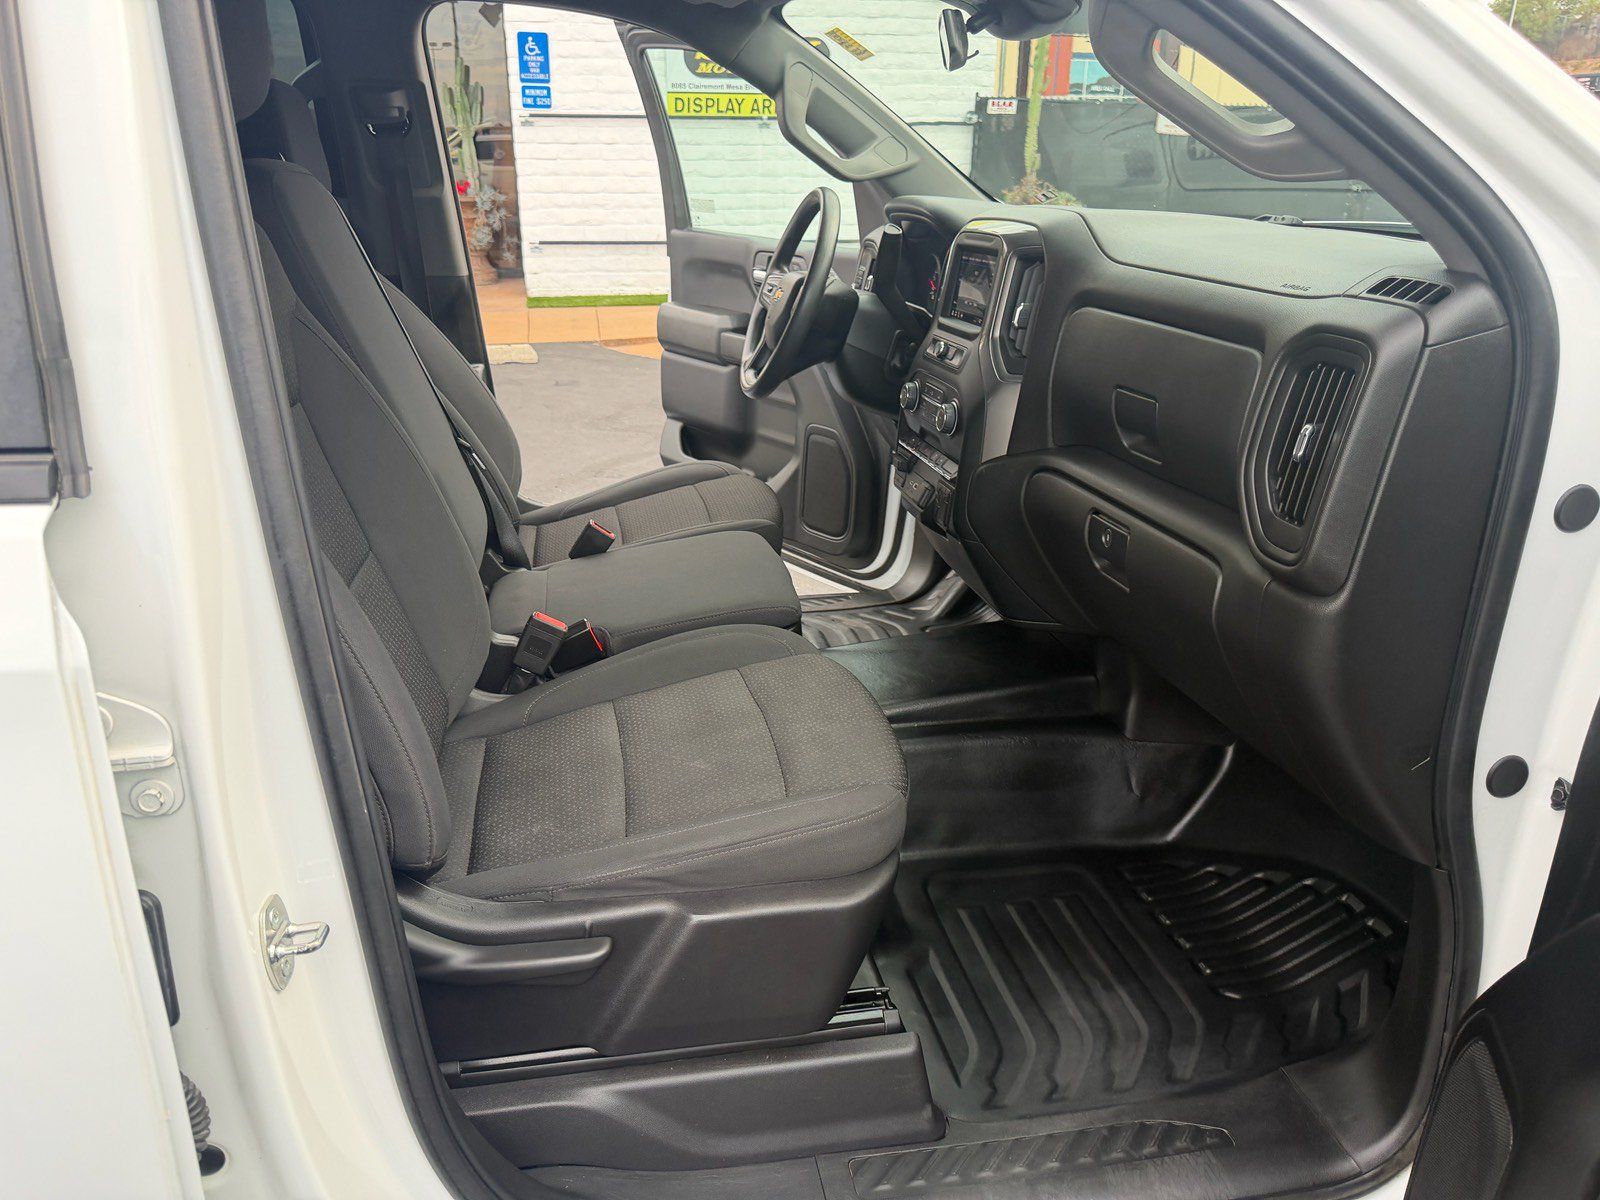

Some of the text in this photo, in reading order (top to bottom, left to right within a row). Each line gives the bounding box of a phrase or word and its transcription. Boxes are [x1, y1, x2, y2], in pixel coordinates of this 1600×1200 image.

[688, 82, 725, 90] Clairemont
[674, 97, 777, 114] DISPLAY AR
